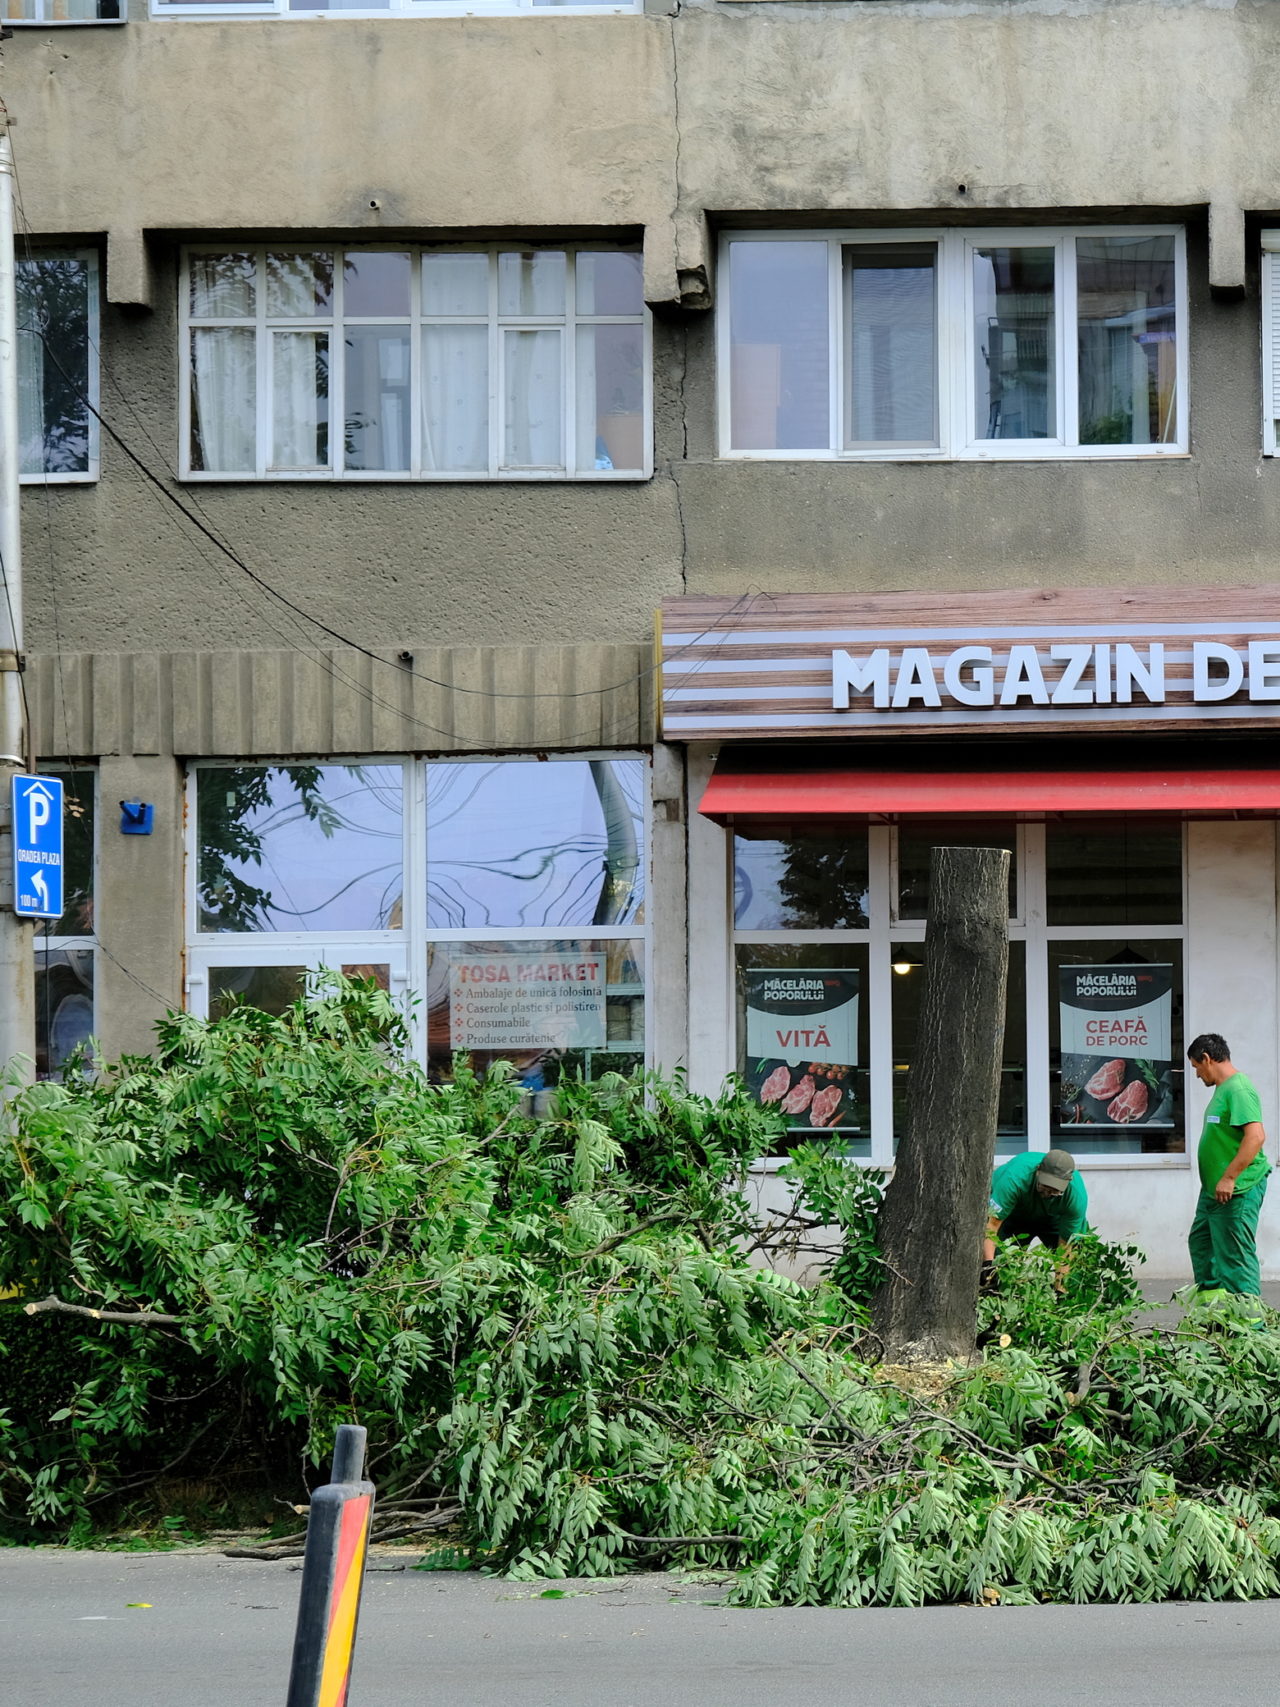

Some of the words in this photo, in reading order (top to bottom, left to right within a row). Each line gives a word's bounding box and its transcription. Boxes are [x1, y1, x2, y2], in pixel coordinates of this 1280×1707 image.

[832, 643, 1166, 709] MAGAZIN
[29, 792, 49, 844] P
[17, 849, 41, 864] ORADEA
[41, 852, 60, 866] PLAZA
[20, 894, 31, 907] 100
[458, 964, 511, 983] TOSA
[517, 963, 599, 982] MARKET
[1076, 973, 1137, 986] MĂCELĂRIA
[764, 978, 824, 990] MĂCELĂRIA
[466, 987, 512, 1000] Ambalaje
[515, 988, 527, 998] de
[530, 986, 556, 998] unică
[764, 991, 824, 1000] POPORULUI
[1076, 986, 1137, 996] POPORULUI
[466, 1003, 509, 1013] Caserole
[511, 1002, 542, 1015] plastic
[556, 1000, 601, 1014] polistiren
[466, 1016, 530, 1028] Consumabile
[1086, 1016, 1147, 1033] CEAFĂ
[466, 1033, 507, 1044] Produse
[776, 1025, 831, 1047] VITĂ
[1086, 1036, 1105, 1046] DE
[1109, 1035, 1148, 1046] PORC
